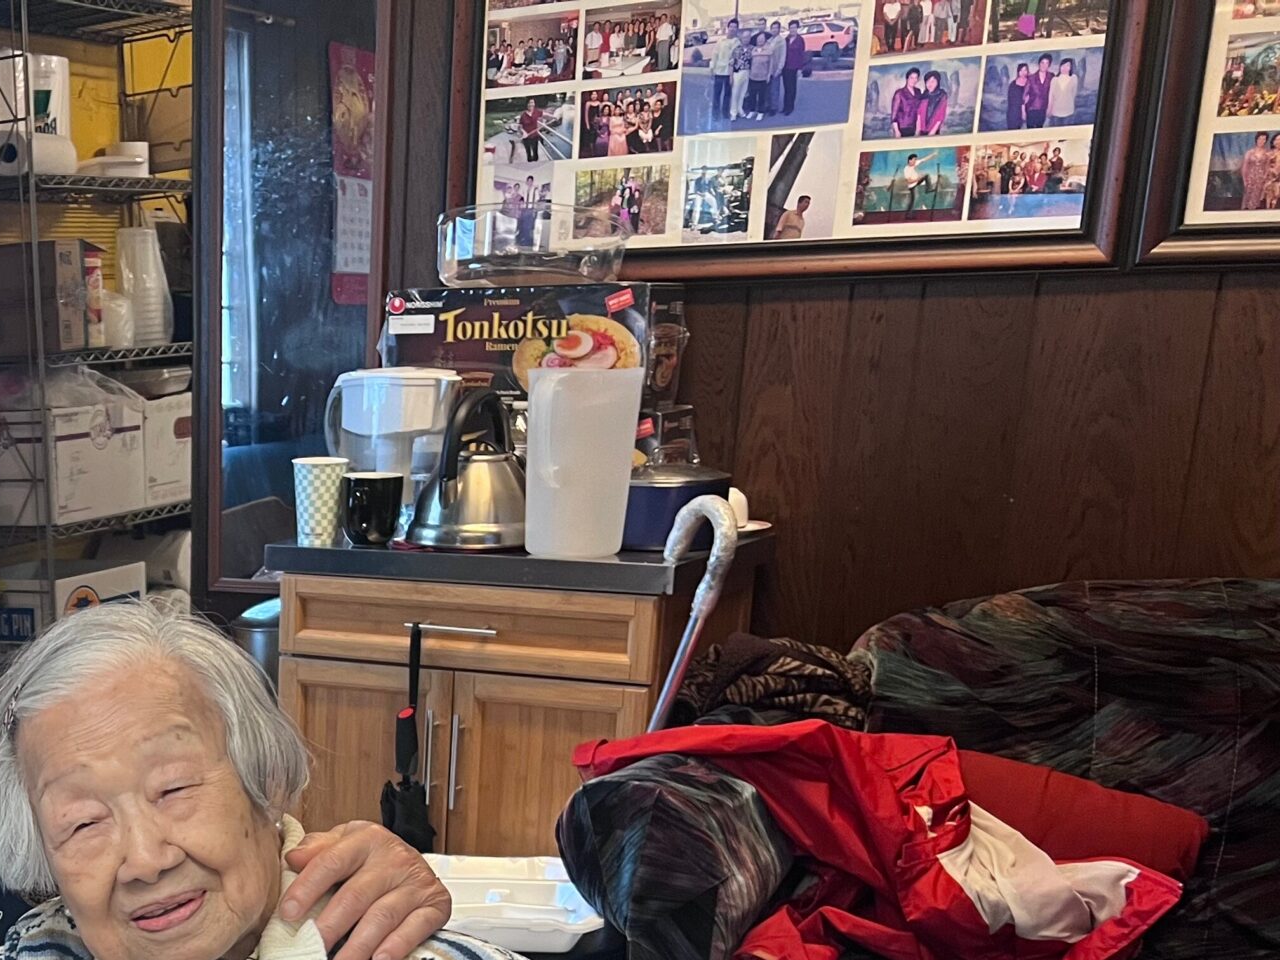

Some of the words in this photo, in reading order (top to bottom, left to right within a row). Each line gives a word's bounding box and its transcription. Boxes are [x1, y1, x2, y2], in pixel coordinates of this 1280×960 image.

[439, 307, 571, 343] Tonkotsu
[485, 342, 518, 351] Ramen
[11, 613, 32, 637] PIN
